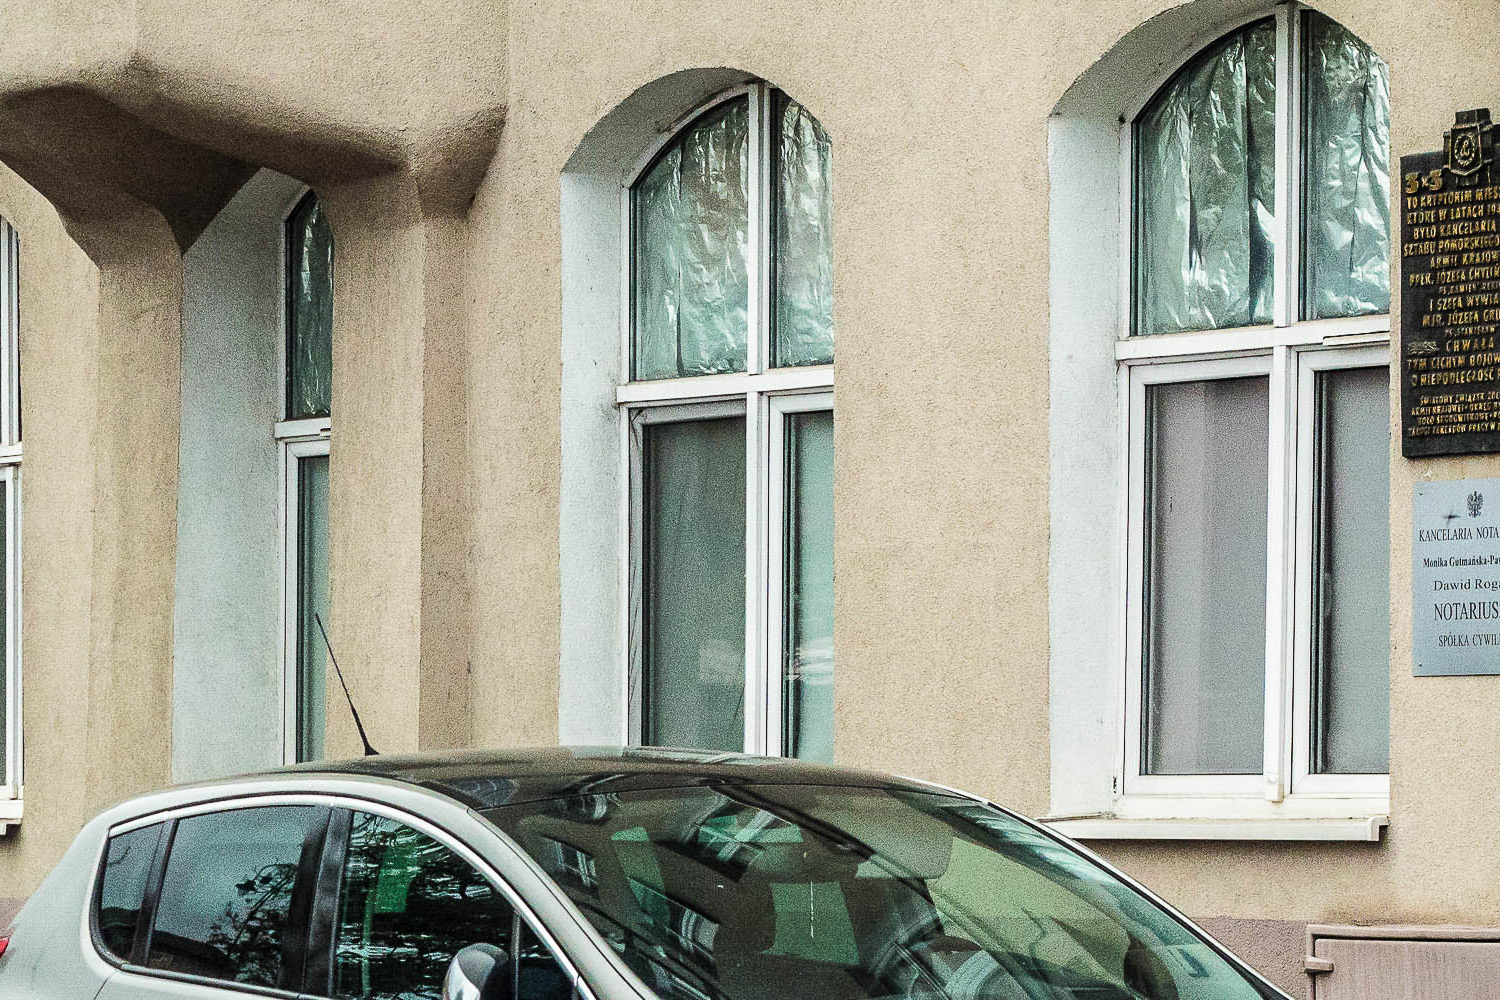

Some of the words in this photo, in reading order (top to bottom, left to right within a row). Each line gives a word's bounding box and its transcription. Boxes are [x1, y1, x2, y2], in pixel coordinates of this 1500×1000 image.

[1438, 208, 1447, 220] W
[1419, 527, 1473, 542] KANCELARIA
[1422, 557, 1448, 568] Monika
[1433, 578, 1471, 591] Dawid
[1433, 600, 1500, 621] NOTARIUS
